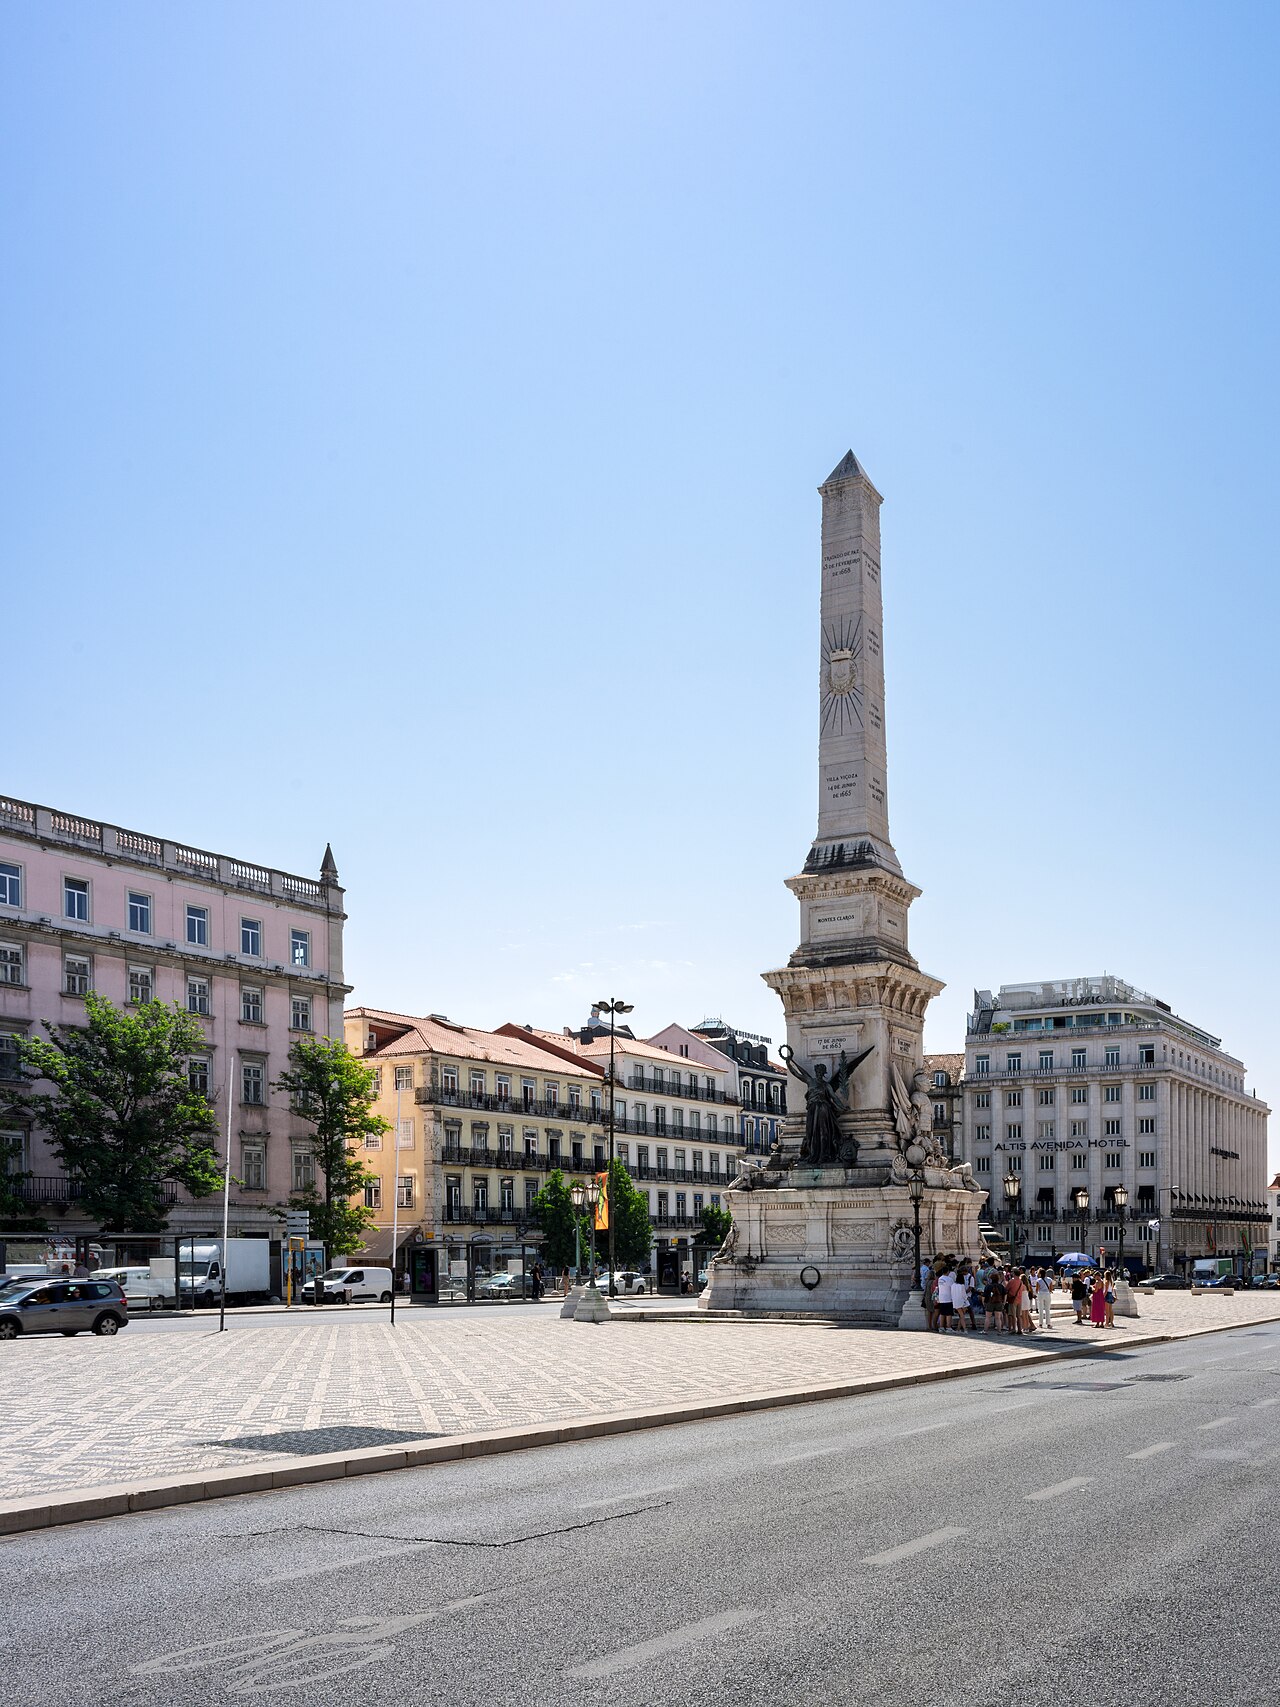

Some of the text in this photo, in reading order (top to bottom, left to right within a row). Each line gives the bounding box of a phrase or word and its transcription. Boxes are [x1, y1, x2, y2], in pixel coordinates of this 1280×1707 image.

[994, 1139, 1130, 1151] ALTIS AVENIDA HOTEL
